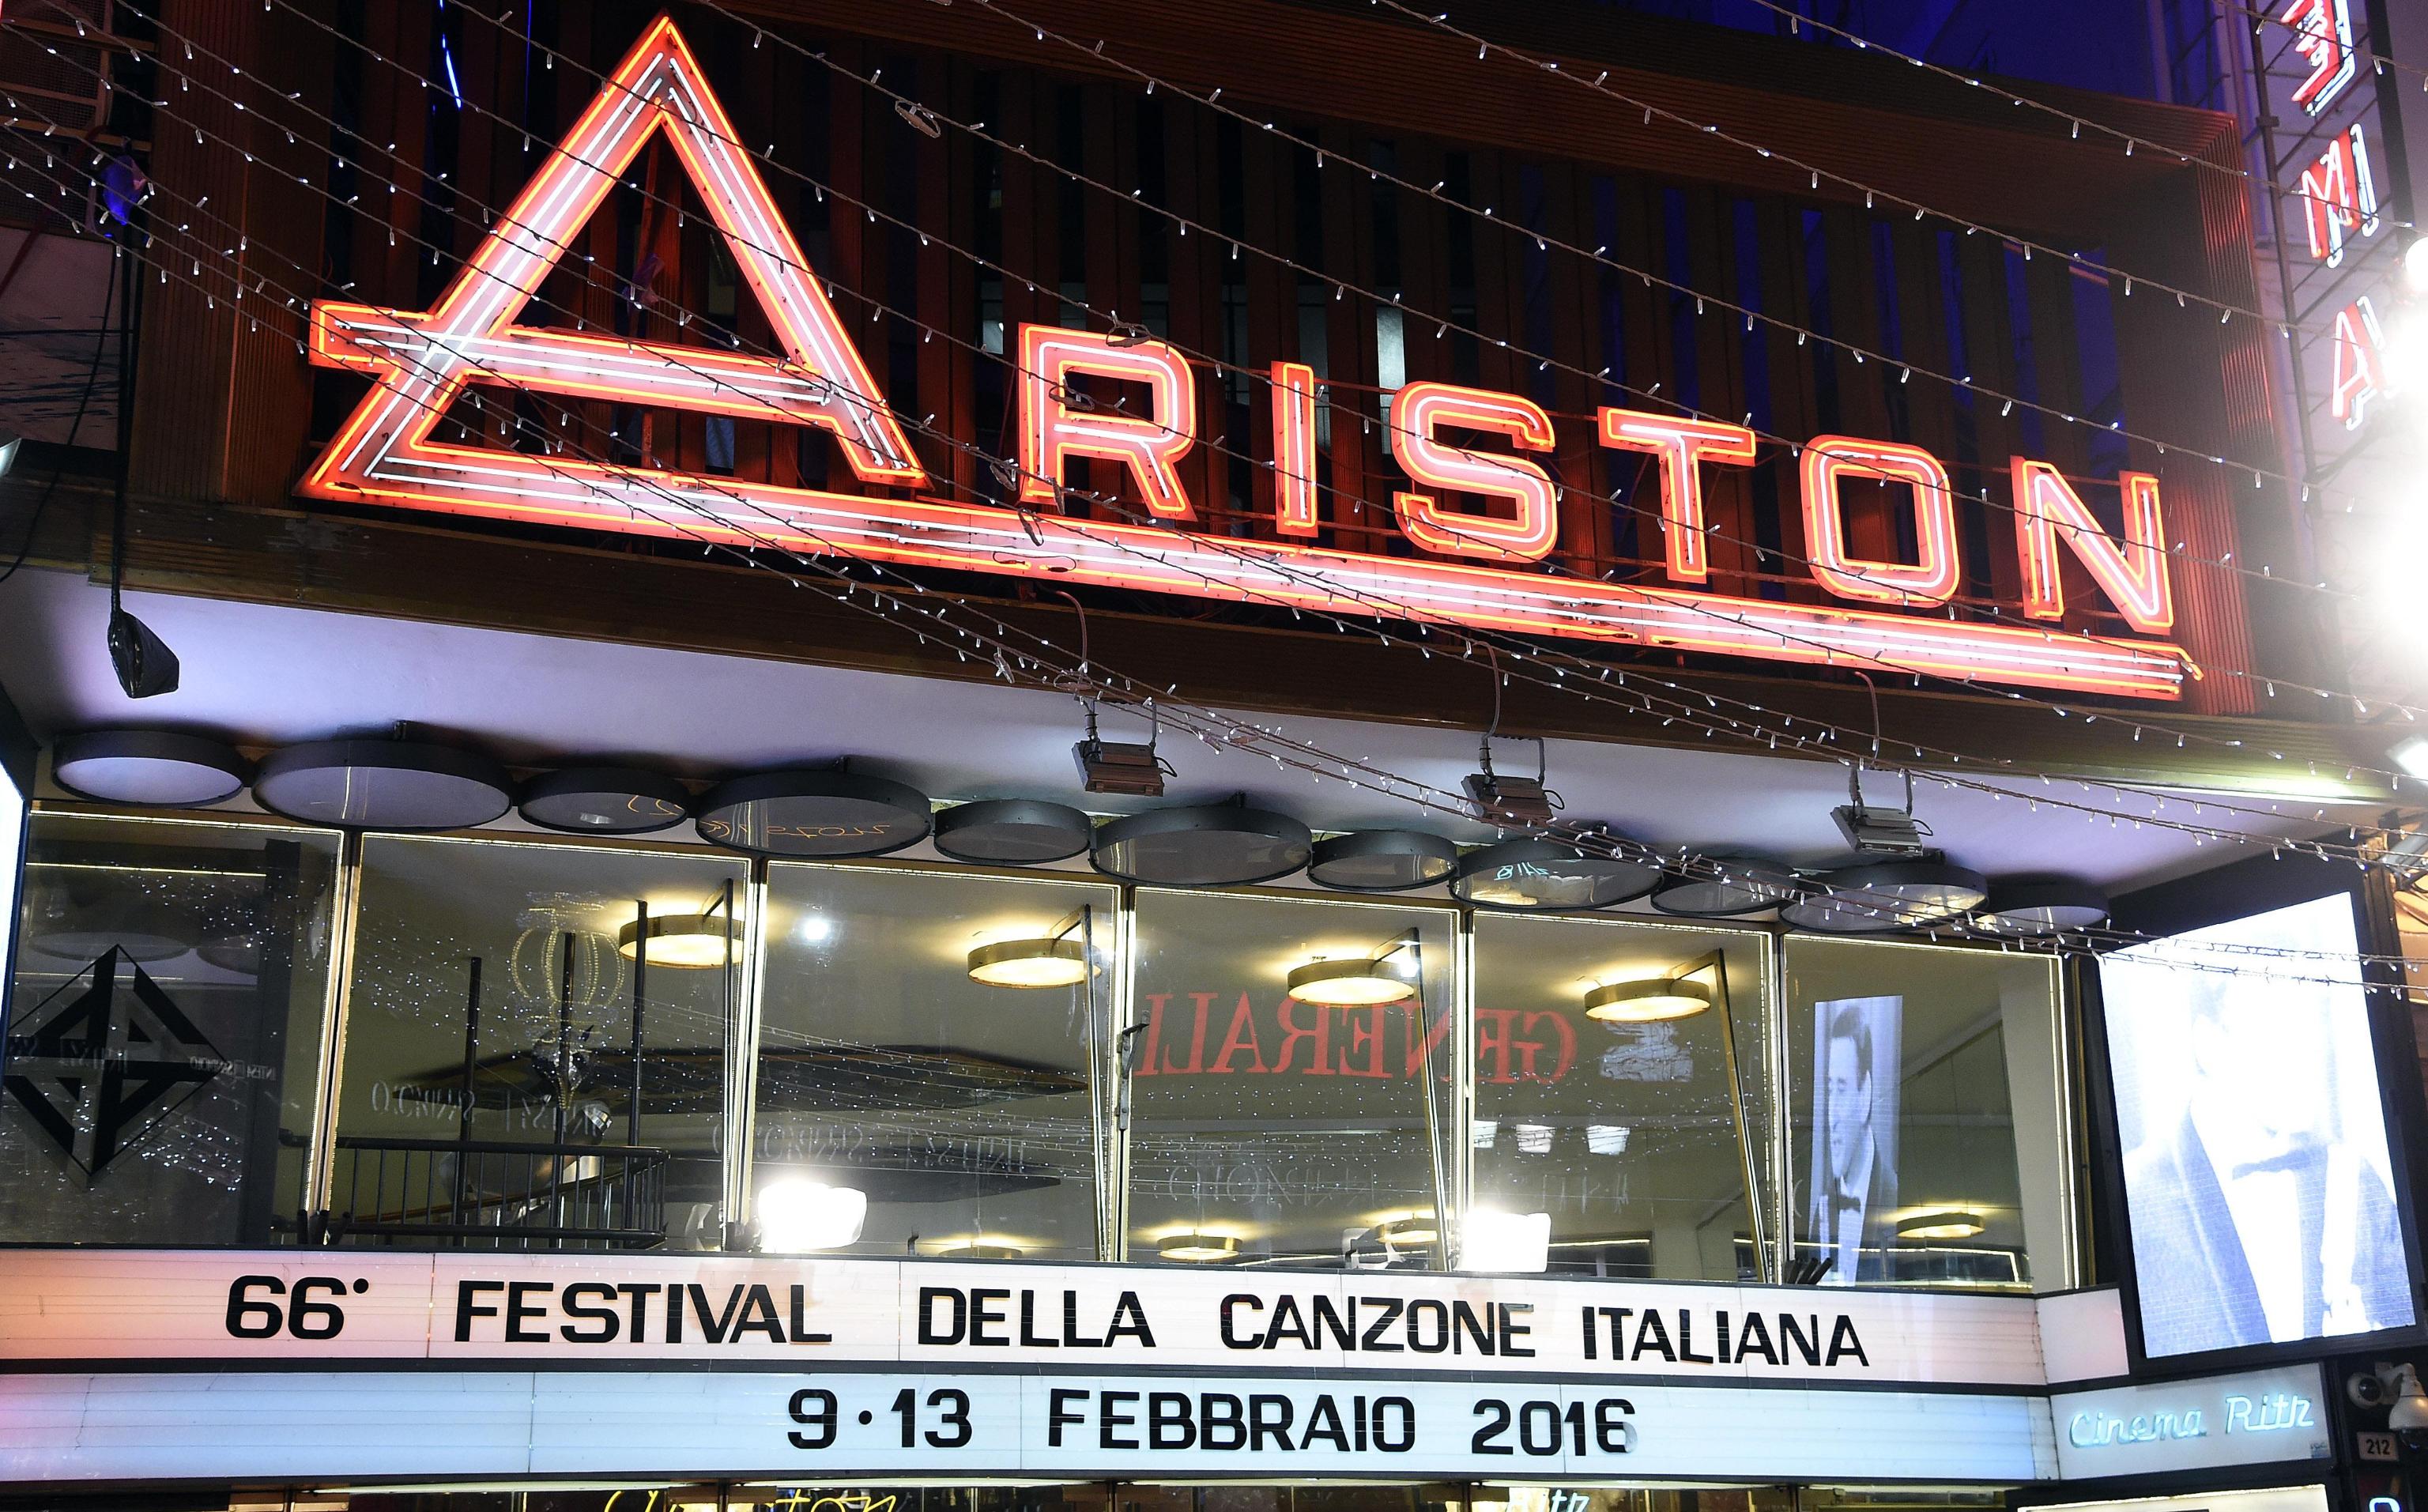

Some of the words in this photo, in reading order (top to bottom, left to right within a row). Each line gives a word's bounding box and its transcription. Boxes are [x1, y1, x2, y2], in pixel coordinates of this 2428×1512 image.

[307, 14, 2204, 700] ARISTON
[454, 1280, 832, 1344] FESTIVAL
[918, 1287, 1156, 1348] DELLA
[1220, 1294, 1536, 1358] CANZONE
[1582, 1307, 1869, 1367] ITALIANA
[1048, 1391, 1416, 1453] FEBBRAIO
[1472, 1398, 1638, 1457] 2016
[2069, 1409, 2207, 1448] Cinema
[2366, 1438, 2391, 1456] 212
